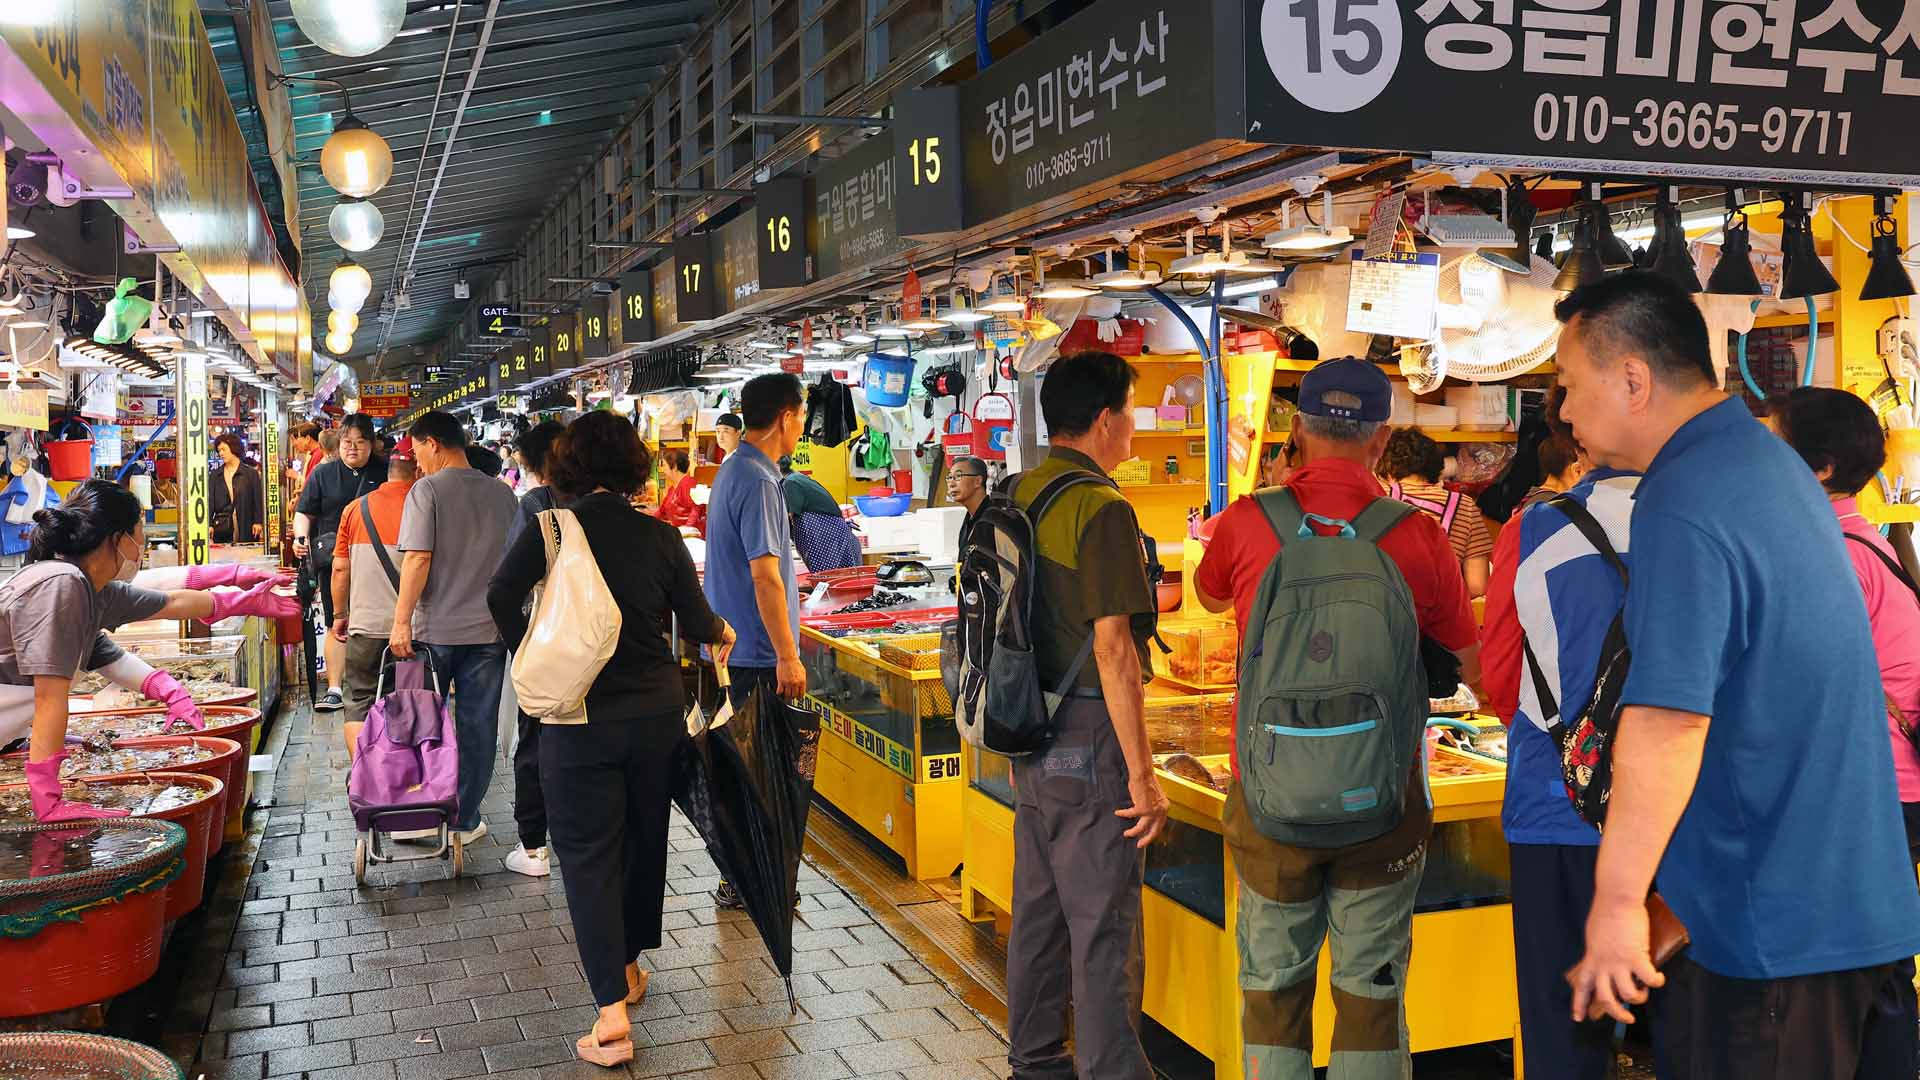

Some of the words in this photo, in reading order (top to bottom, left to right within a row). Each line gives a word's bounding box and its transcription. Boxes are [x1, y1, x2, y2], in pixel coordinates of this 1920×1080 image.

[1289, 0, 1383, 76] 15
[985, 10, 1169, 165] 정읍미현수산
[1533, 92, 1852, 156] 010-3665-9711
[909, 136, 942, 186] 15
[1025, 132, 1112, 190] 010-3665-9711
[767, 216, 791, 253] 16
[683, 263, 701, 293] 17
[482, 307, 509, 316] GATE
[627, 295, 643, 319] 18
[489, 317, 504, 333] 4
[587, 317, 601, 338] 19
[557, 333, 569, 351] 20
[515, 356, 525, 371] 22
[534, 346, 545, 362] 21
[477, 376, 486, 388] 24
[500, 364, 510, 378] 23
[500, 394, 517, 407] 24
[833, 713, 852, 741] 도미
[854, 722, 886, 761] 놀래미
[888, 743, 913, 776] 농어
[928, 756, 961, 779] 광어
